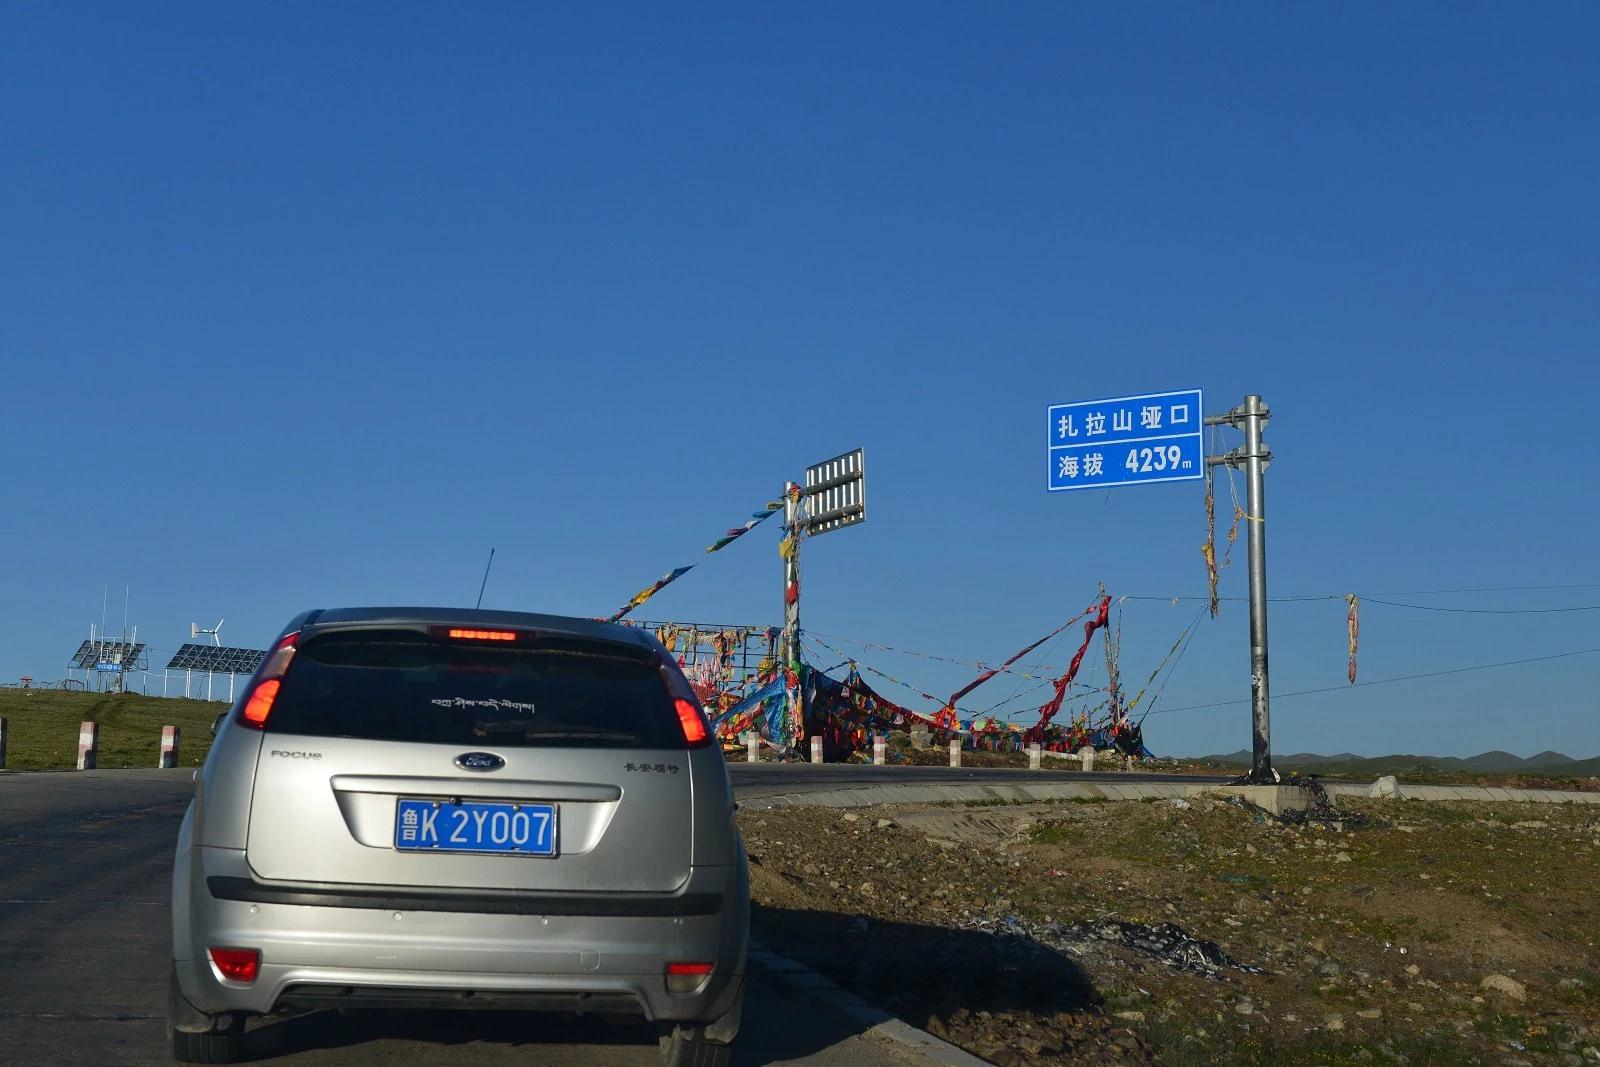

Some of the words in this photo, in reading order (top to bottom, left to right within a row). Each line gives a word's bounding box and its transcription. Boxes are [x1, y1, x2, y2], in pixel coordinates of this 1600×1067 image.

[1058, 404, 1189, 439] 扎拉山垭口
[1058, 453, 1104, 479] 海拔
[271, 750, 323, 760] FOCUS
